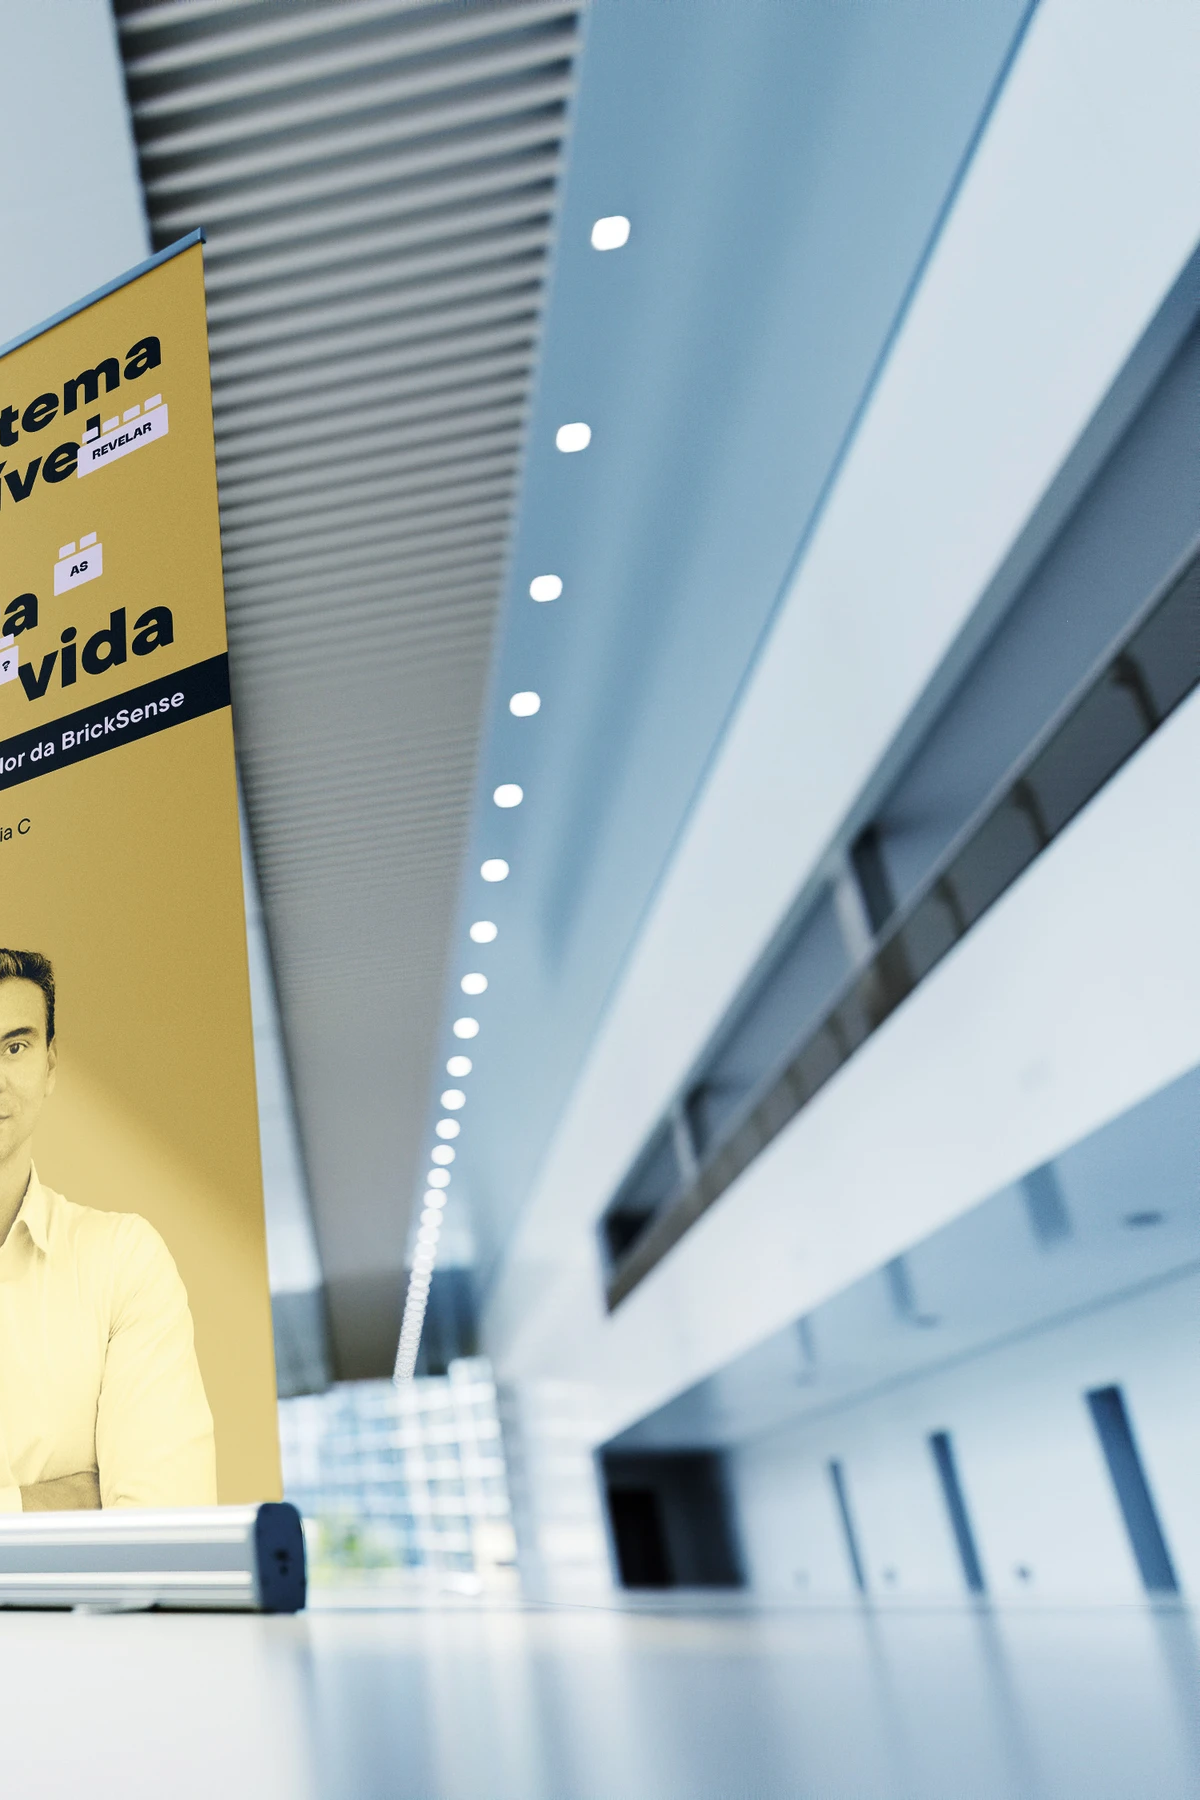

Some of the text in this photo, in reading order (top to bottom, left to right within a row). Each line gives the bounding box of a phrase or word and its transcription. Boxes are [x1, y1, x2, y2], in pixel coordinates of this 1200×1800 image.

[92, 422, 152, 460] REVELAR
[69, 560, 89, 577] AS
[2, 660, 11, 672] ?
[18, 606, 174, 702] vida
[29, 741, 56, 763] da
[61, 691, 186, 751] BrickSense
[17, 818, 31, 835] C
